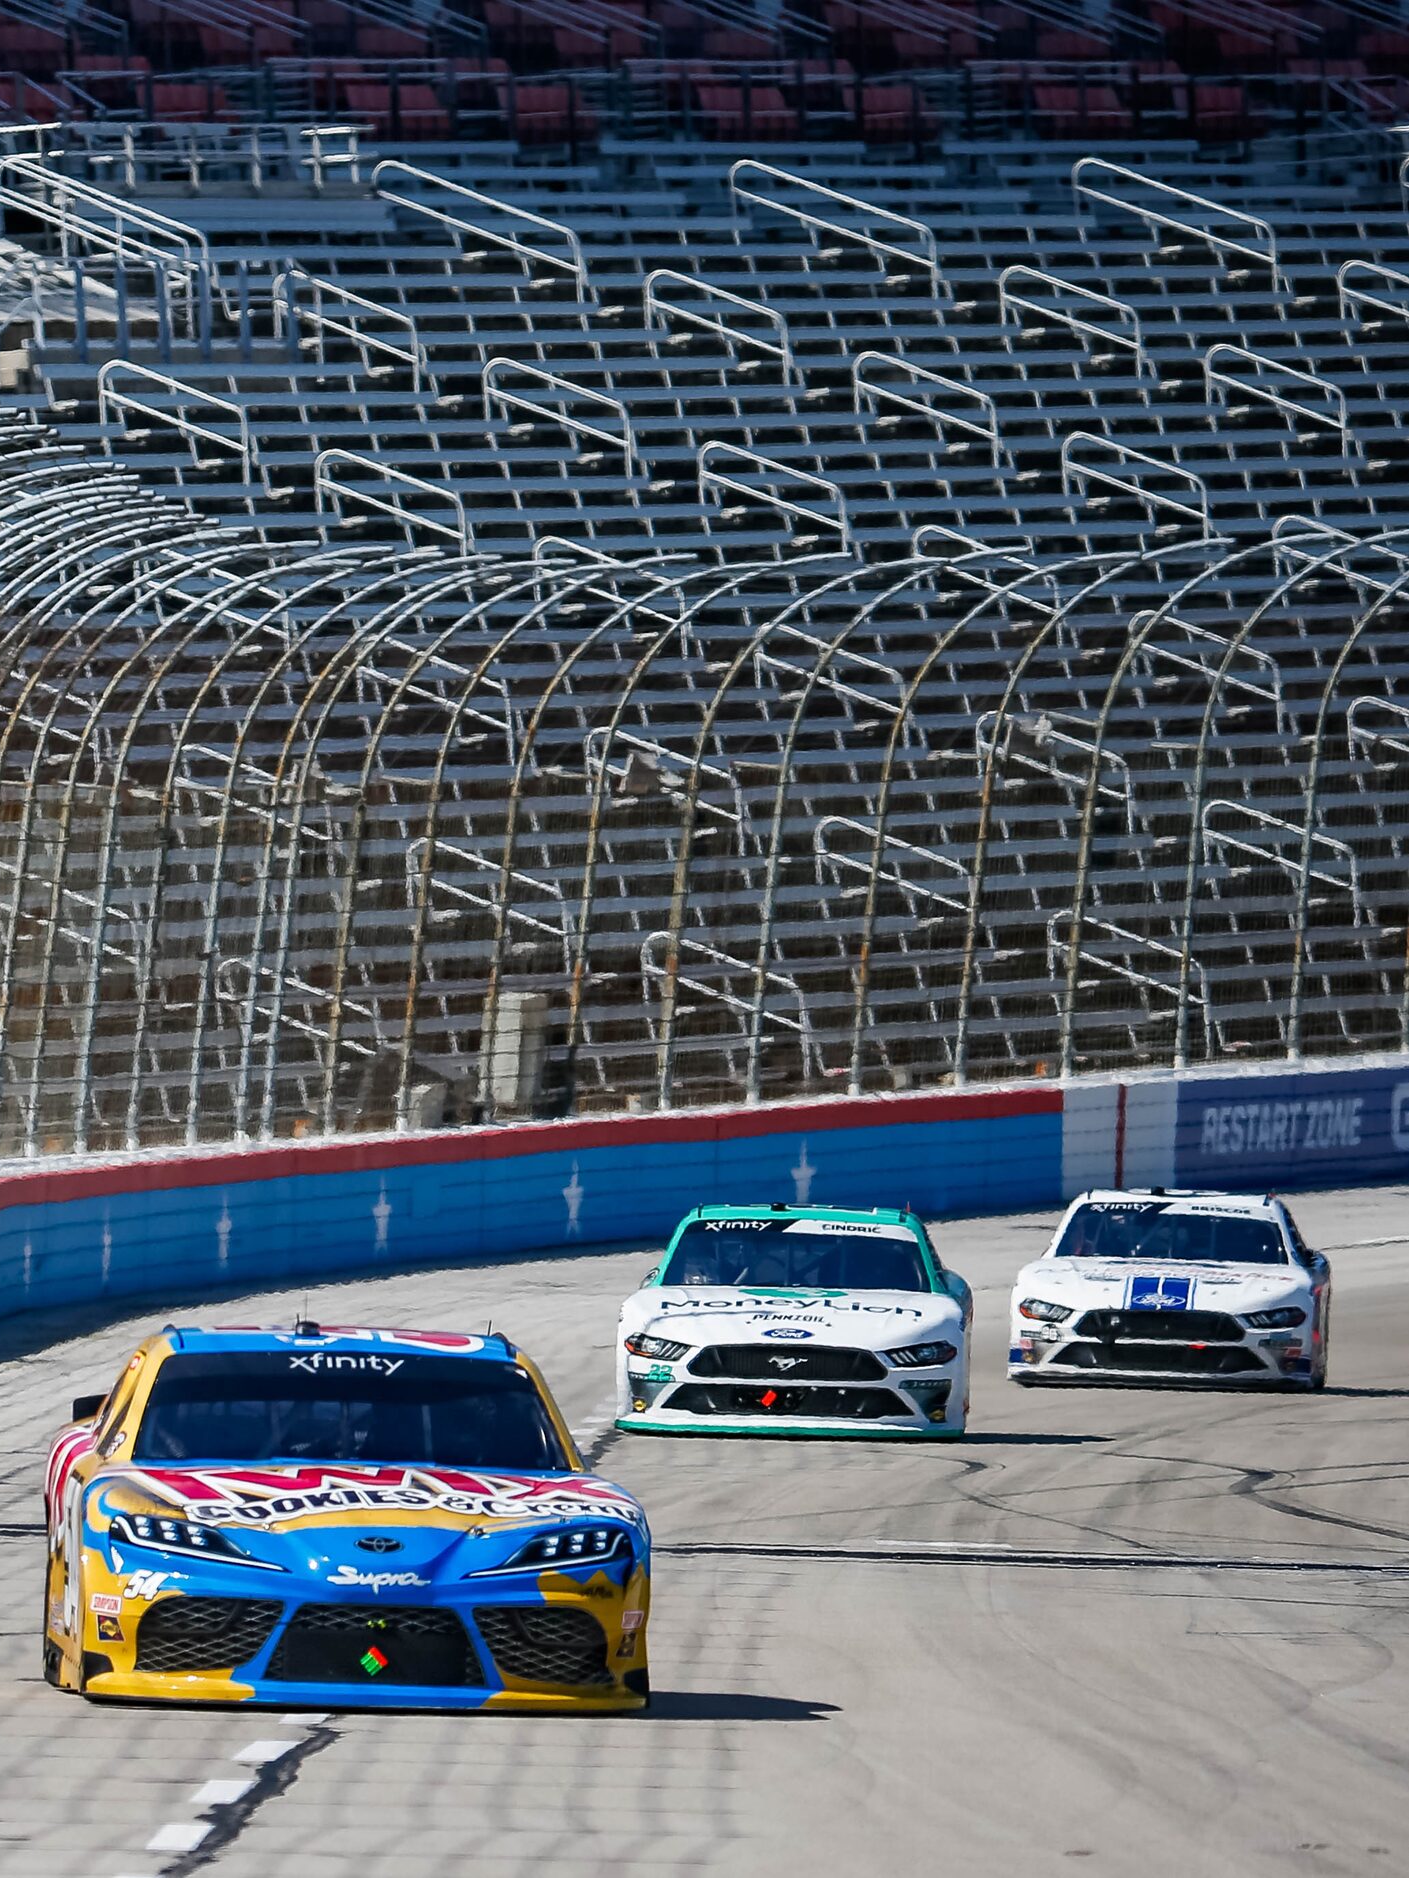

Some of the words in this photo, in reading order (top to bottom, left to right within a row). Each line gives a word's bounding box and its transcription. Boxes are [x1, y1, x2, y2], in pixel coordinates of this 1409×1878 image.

[1201, 1102, 1303, 1153] RESTART
[1303, 1098, 1364, 1148] ZONE
[704, 1221, 773, 1233] xfinity
[821, 1223, 882, 1234] CINDRIC
[660, 1298, 923, 1319] MoneyLion
[770, 1329, 807, 1340] Ford
[289, 1353, 405, 1376] xfinity
[648, 1363, 673, 1381] 22
[132, 1465, 636, 1508] TWIX
[192, 1488, 437, 1522] COOKIES
[443, 1495, 477, 1513] &
[123, 1569, 170, 1600] 54
[326, 1565, 432, 1595] Supra
